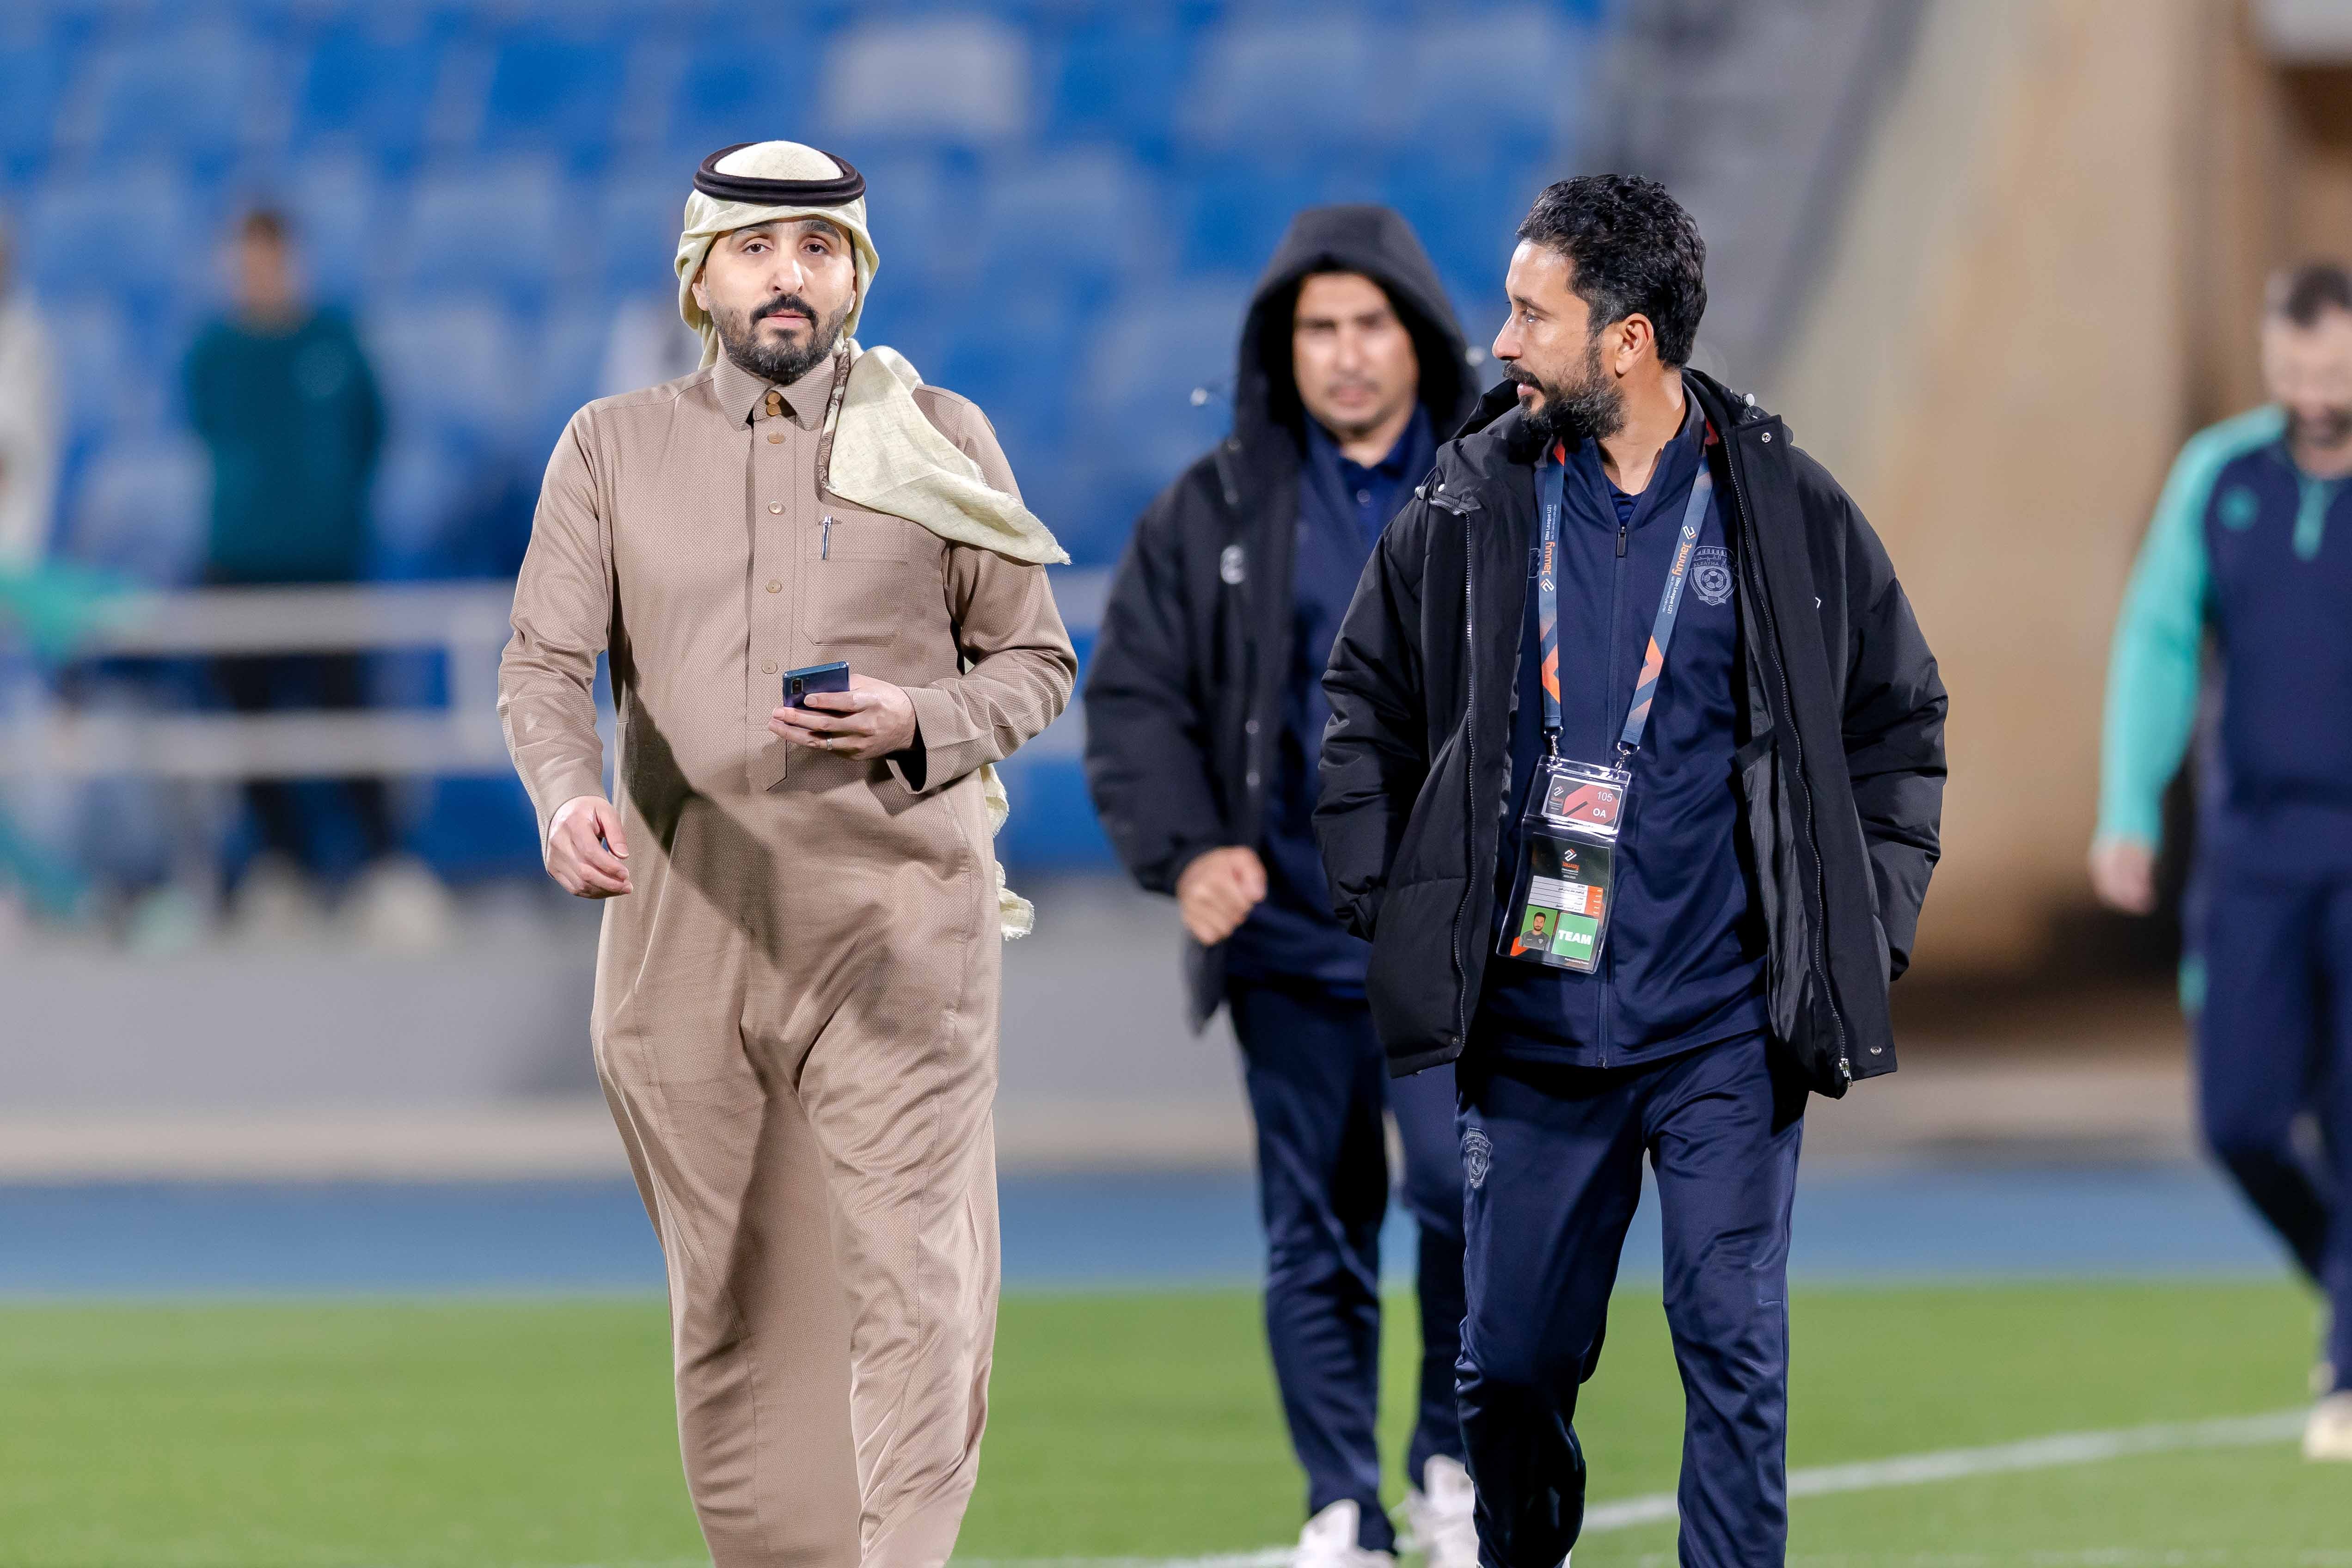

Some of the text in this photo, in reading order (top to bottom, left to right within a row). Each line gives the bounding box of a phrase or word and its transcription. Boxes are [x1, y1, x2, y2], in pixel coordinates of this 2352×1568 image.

[1542, 541, 1555, 575] Jawwy
[1672, 542, 1692, 576] Jawwy
[1669, 587, 1679, 604] League
[1597, 791, 1612, 802] 105
[1592, 808, 1606, 818] OA
[1558, 930, 1592, 945] TEAM
